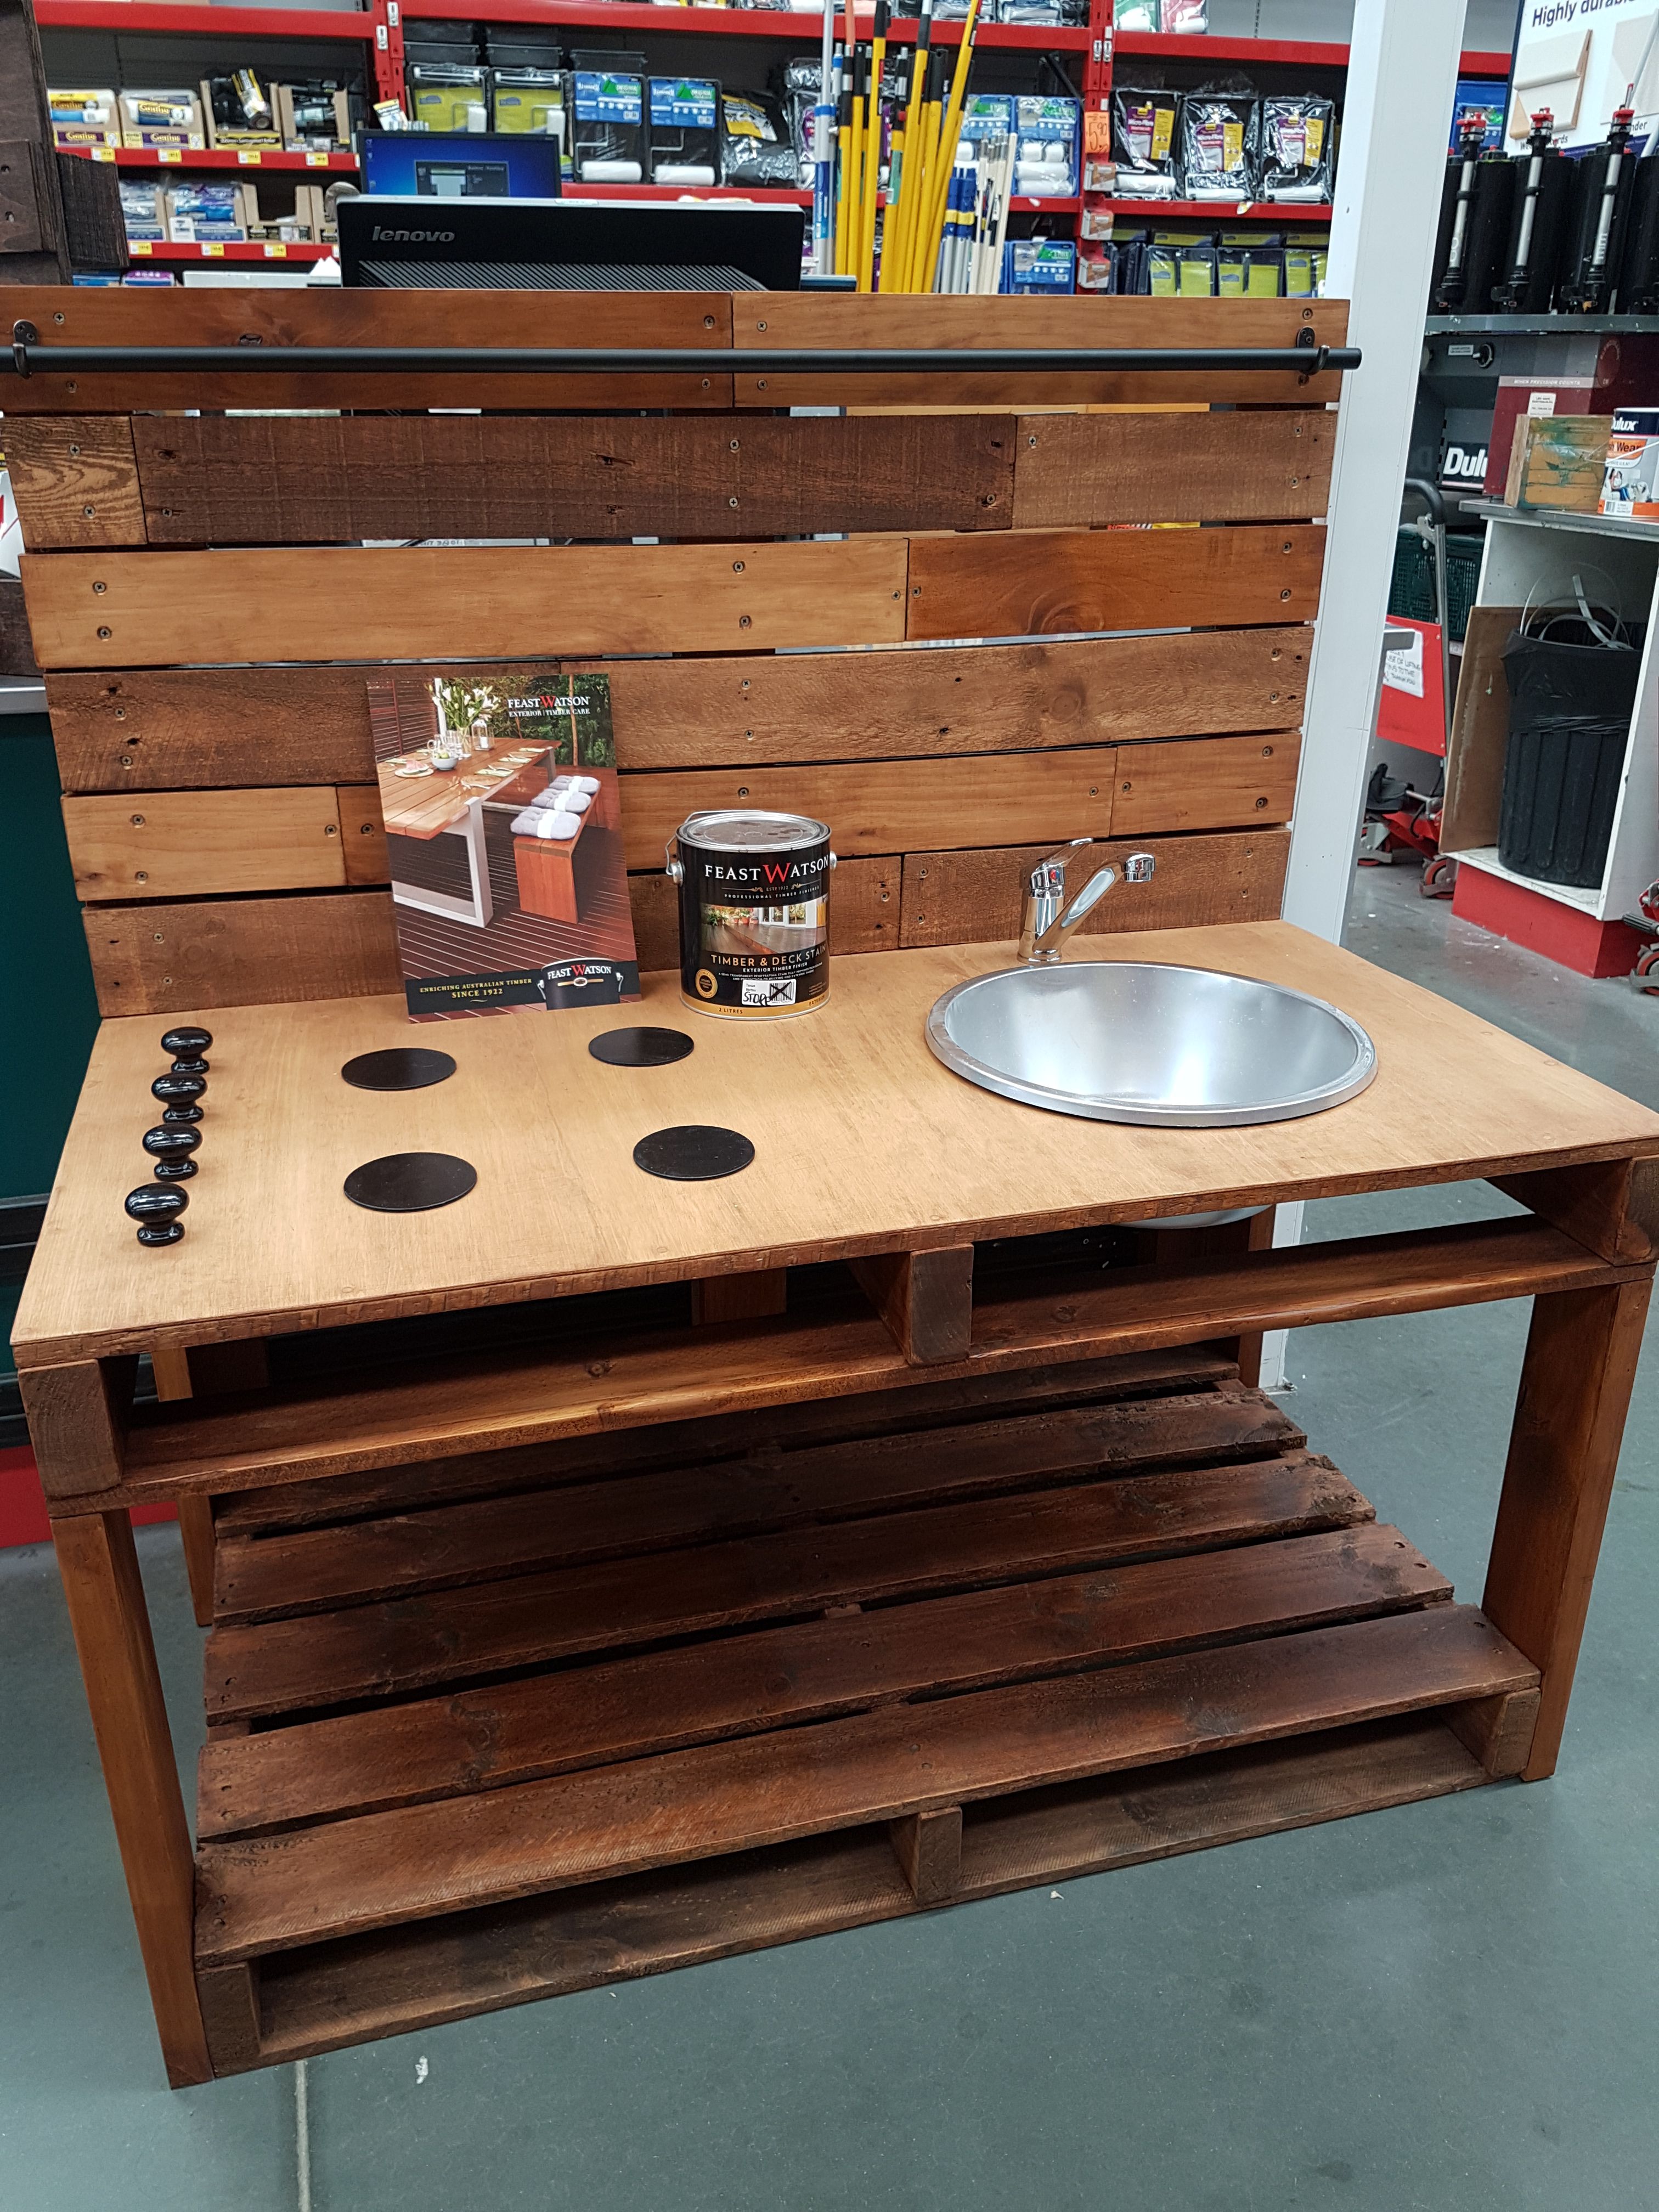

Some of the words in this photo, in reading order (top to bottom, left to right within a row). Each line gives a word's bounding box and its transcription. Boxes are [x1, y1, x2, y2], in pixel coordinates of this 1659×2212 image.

[1532, 1, 1577, 27] Highly
[371, 225, 455, 242] lenovo
[1611, 416, 1637, 431] ulux
[507, 698, 540, 708] FEAST
[539, 695, 590, 708] WATSON
[704, 865, 761, 881] FEAST
[763, 854, 829, 884] WATSON
[711, 955, 754, 967] TIMBER
[760, 957, 768, 966] &
[772, 953, 802, 966] DECK
[805, 944, 826, 960] STAIN
[548, 968, 572, 980] FEAST
[570, 964, 612, 977] WATSON
[419, 984, 460, 993] ENRICHING
[461, 980, 504, 990] AUSTRALIAN
[452, 990, 480, 998] SINCE
